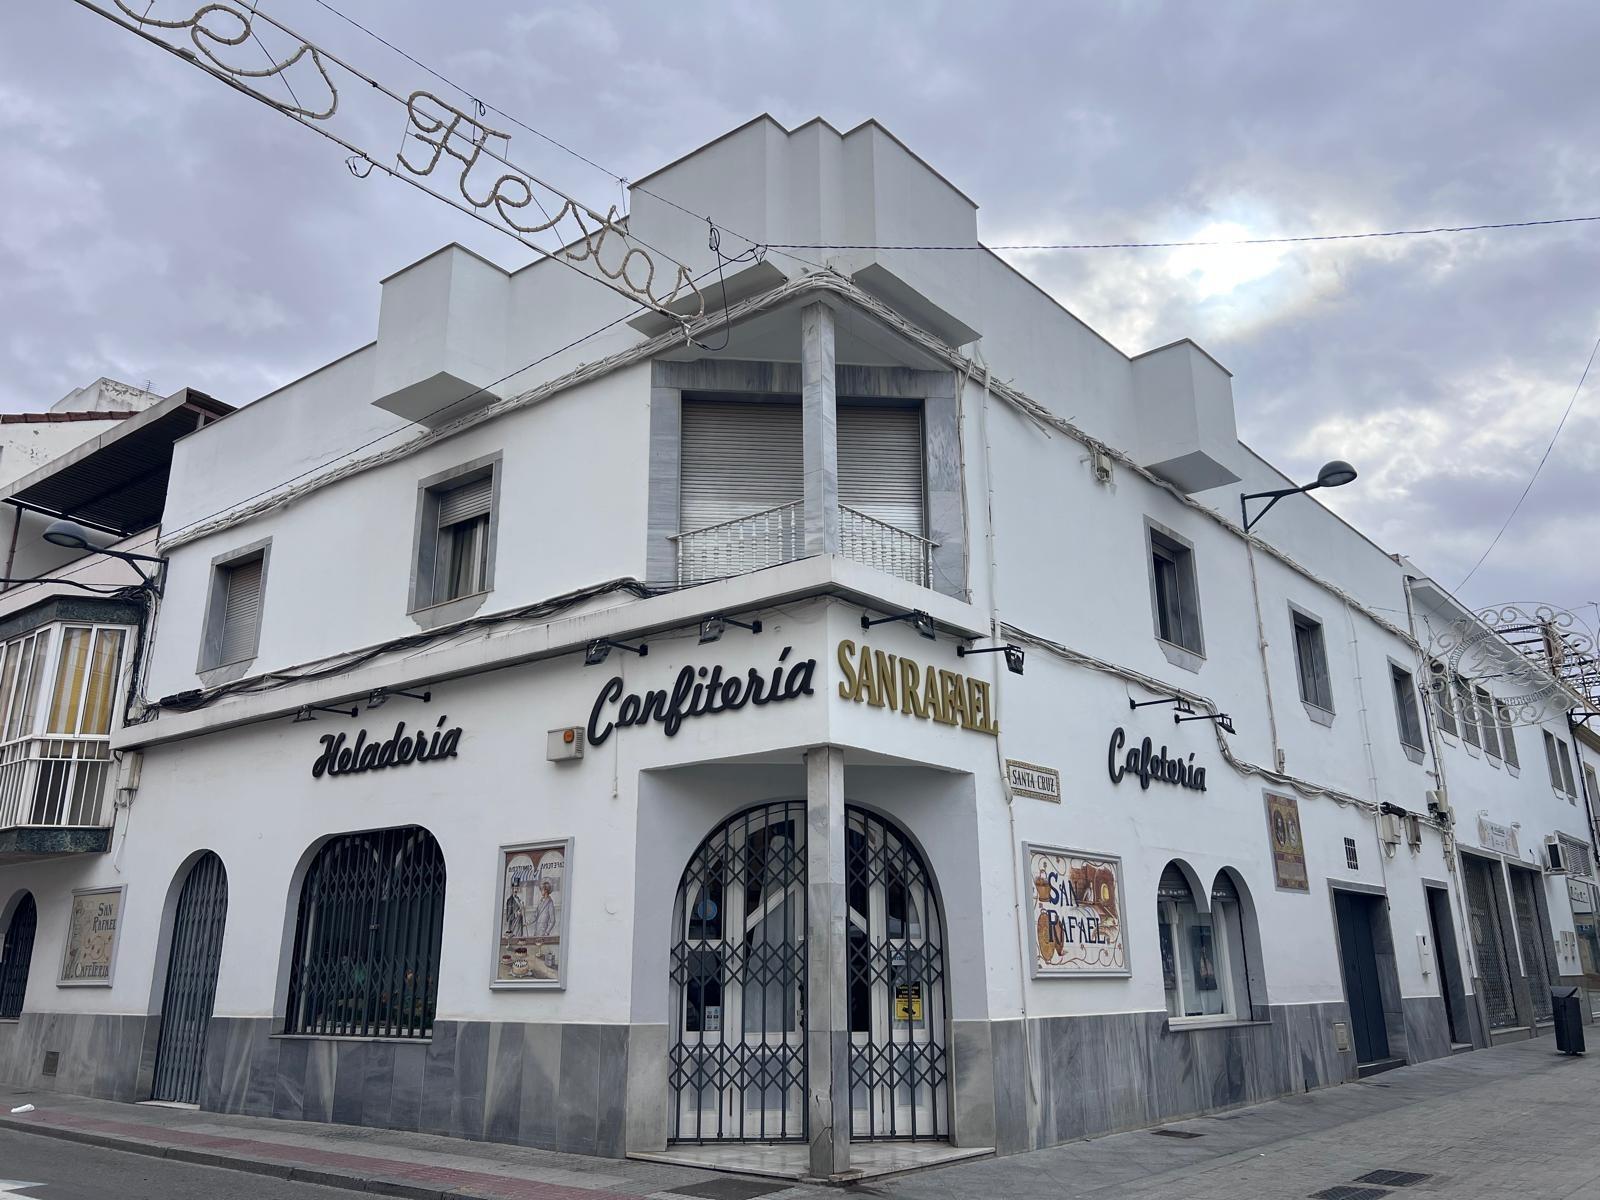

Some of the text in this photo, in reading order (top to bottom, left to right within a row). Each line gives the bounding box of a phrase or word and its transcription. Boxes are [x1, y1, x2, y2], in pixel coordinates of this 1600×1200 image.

[587, 646, 816, 746] Confitería
[837, 639, 998, 736] SAN RAFAEL
[312, 715, 462, 778] Heladería
[1108, 727, 1206, 791] Cafetería
[1012, 769, 1055, 792] SANTA CRUZ
[1048, 871, 1080, 907] SAN
[92, 916, 117, 933] RAFAEL
[98, 903, 113, 916] SAN
[1047, 909, 1106, 944] RAFAEL
